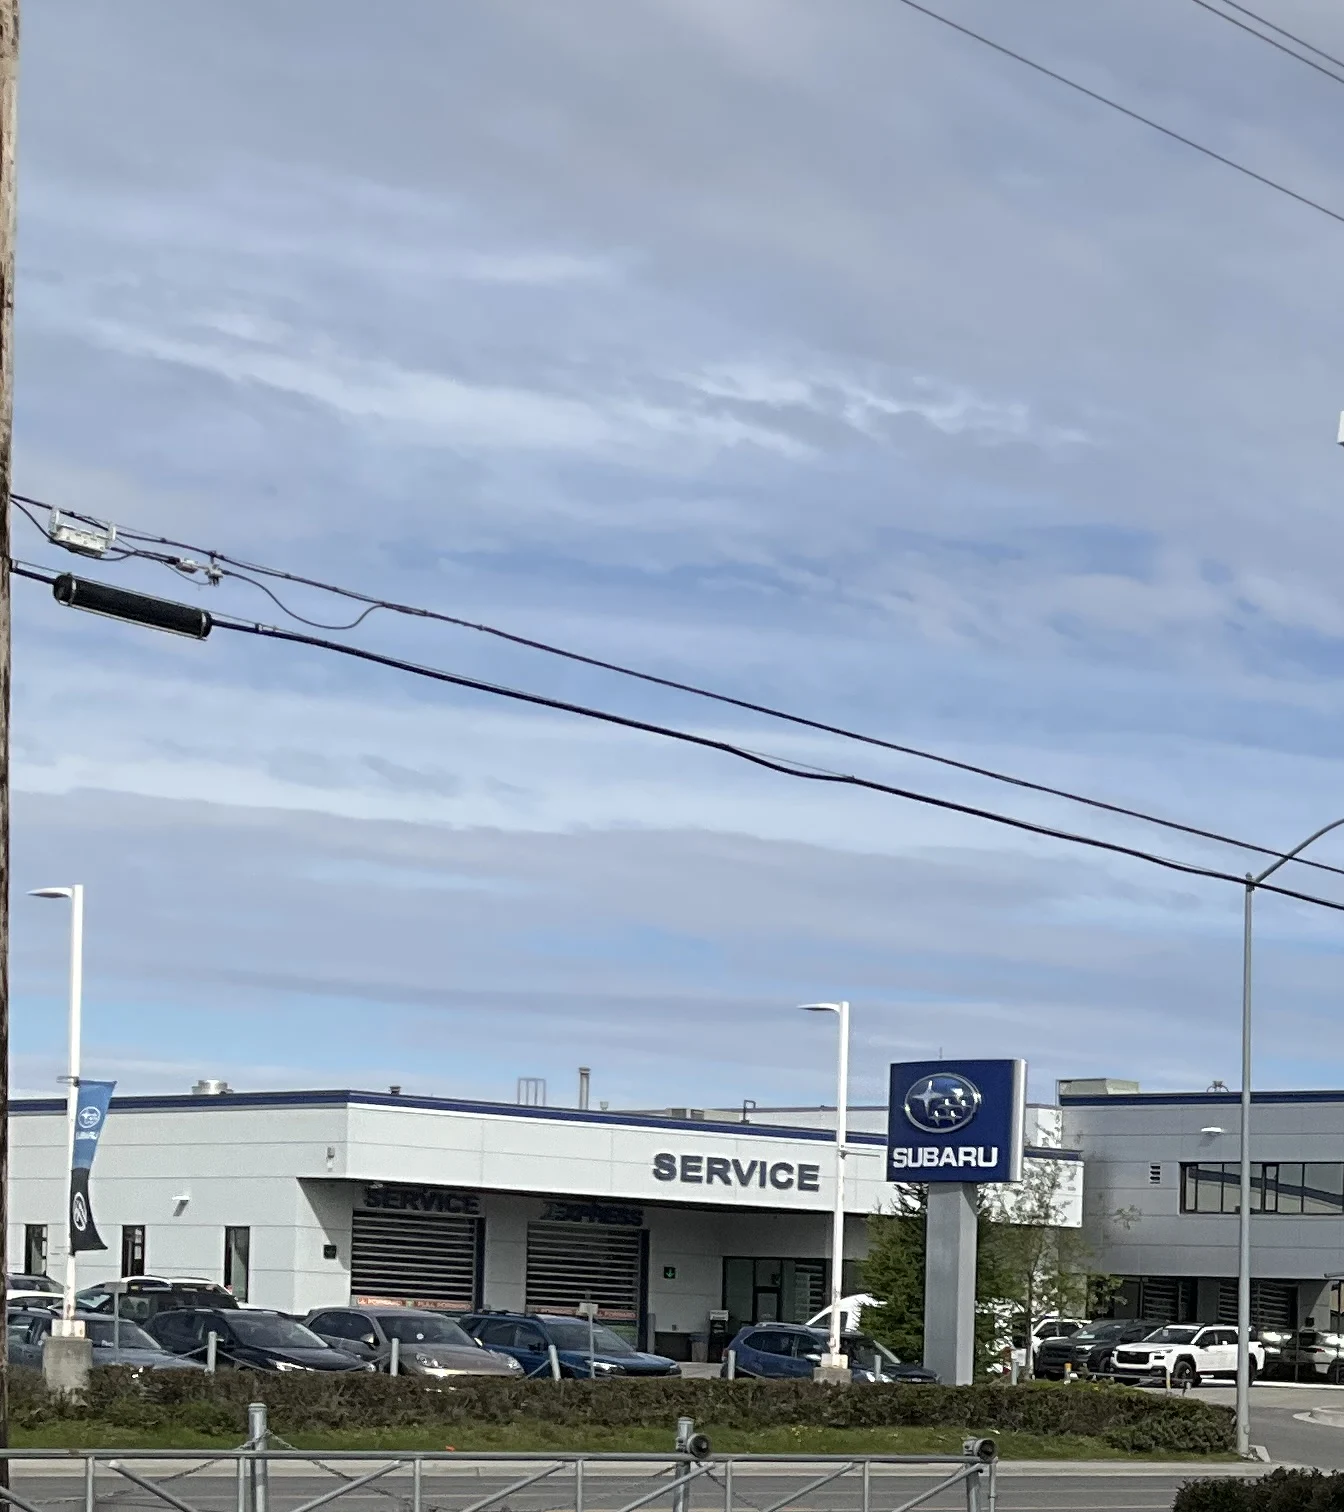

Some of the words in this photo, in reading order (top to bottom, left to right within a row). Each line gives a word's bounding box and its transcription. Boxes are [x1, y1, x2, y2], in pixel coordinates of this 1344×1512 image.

[892, 1145, 999, 1169] SUBARU
[653, 1152, 820, 1192] SERVICE
[363, 1186, 482, 1215] SERVICE
